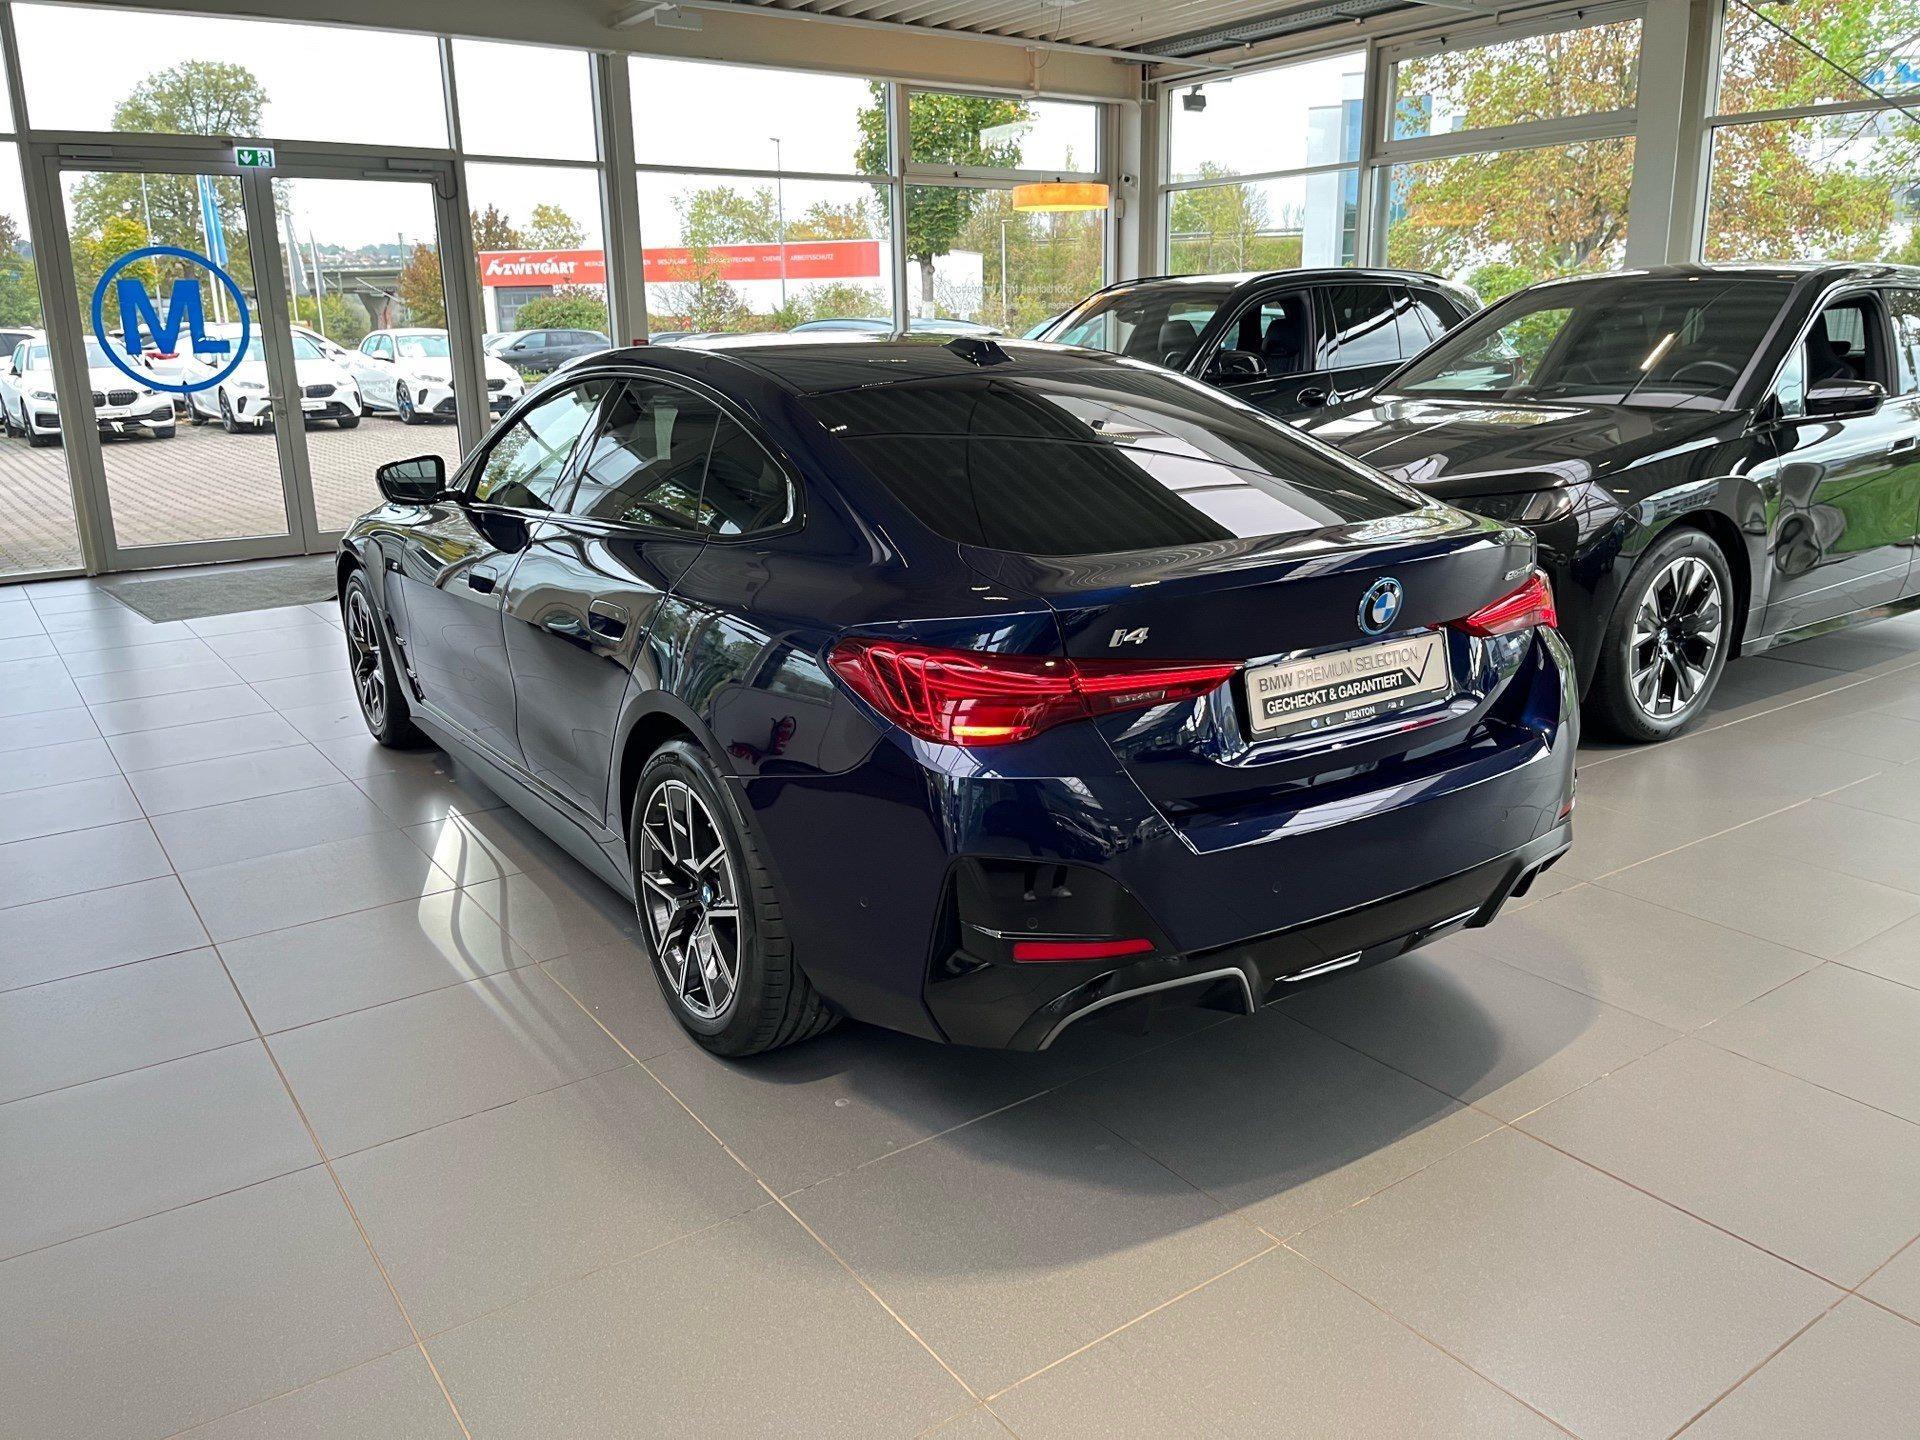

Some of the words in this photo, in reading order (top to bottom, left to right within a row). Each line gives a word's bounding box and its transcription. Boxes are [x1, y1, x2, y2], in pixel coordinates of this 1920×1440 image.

[501, 260, 576, 275] ZWEYGART
[1108, 627, 1150, 648] i4
[1258, 672, 1294, 693] BMW
[1296, 659, 1354, 687] PREMIUM
[1266, 689, 1328, 715] GECHECKT
[1329, 688, 1338, 701] &
[1338, 672, 1404, 698] GARANTIERT
